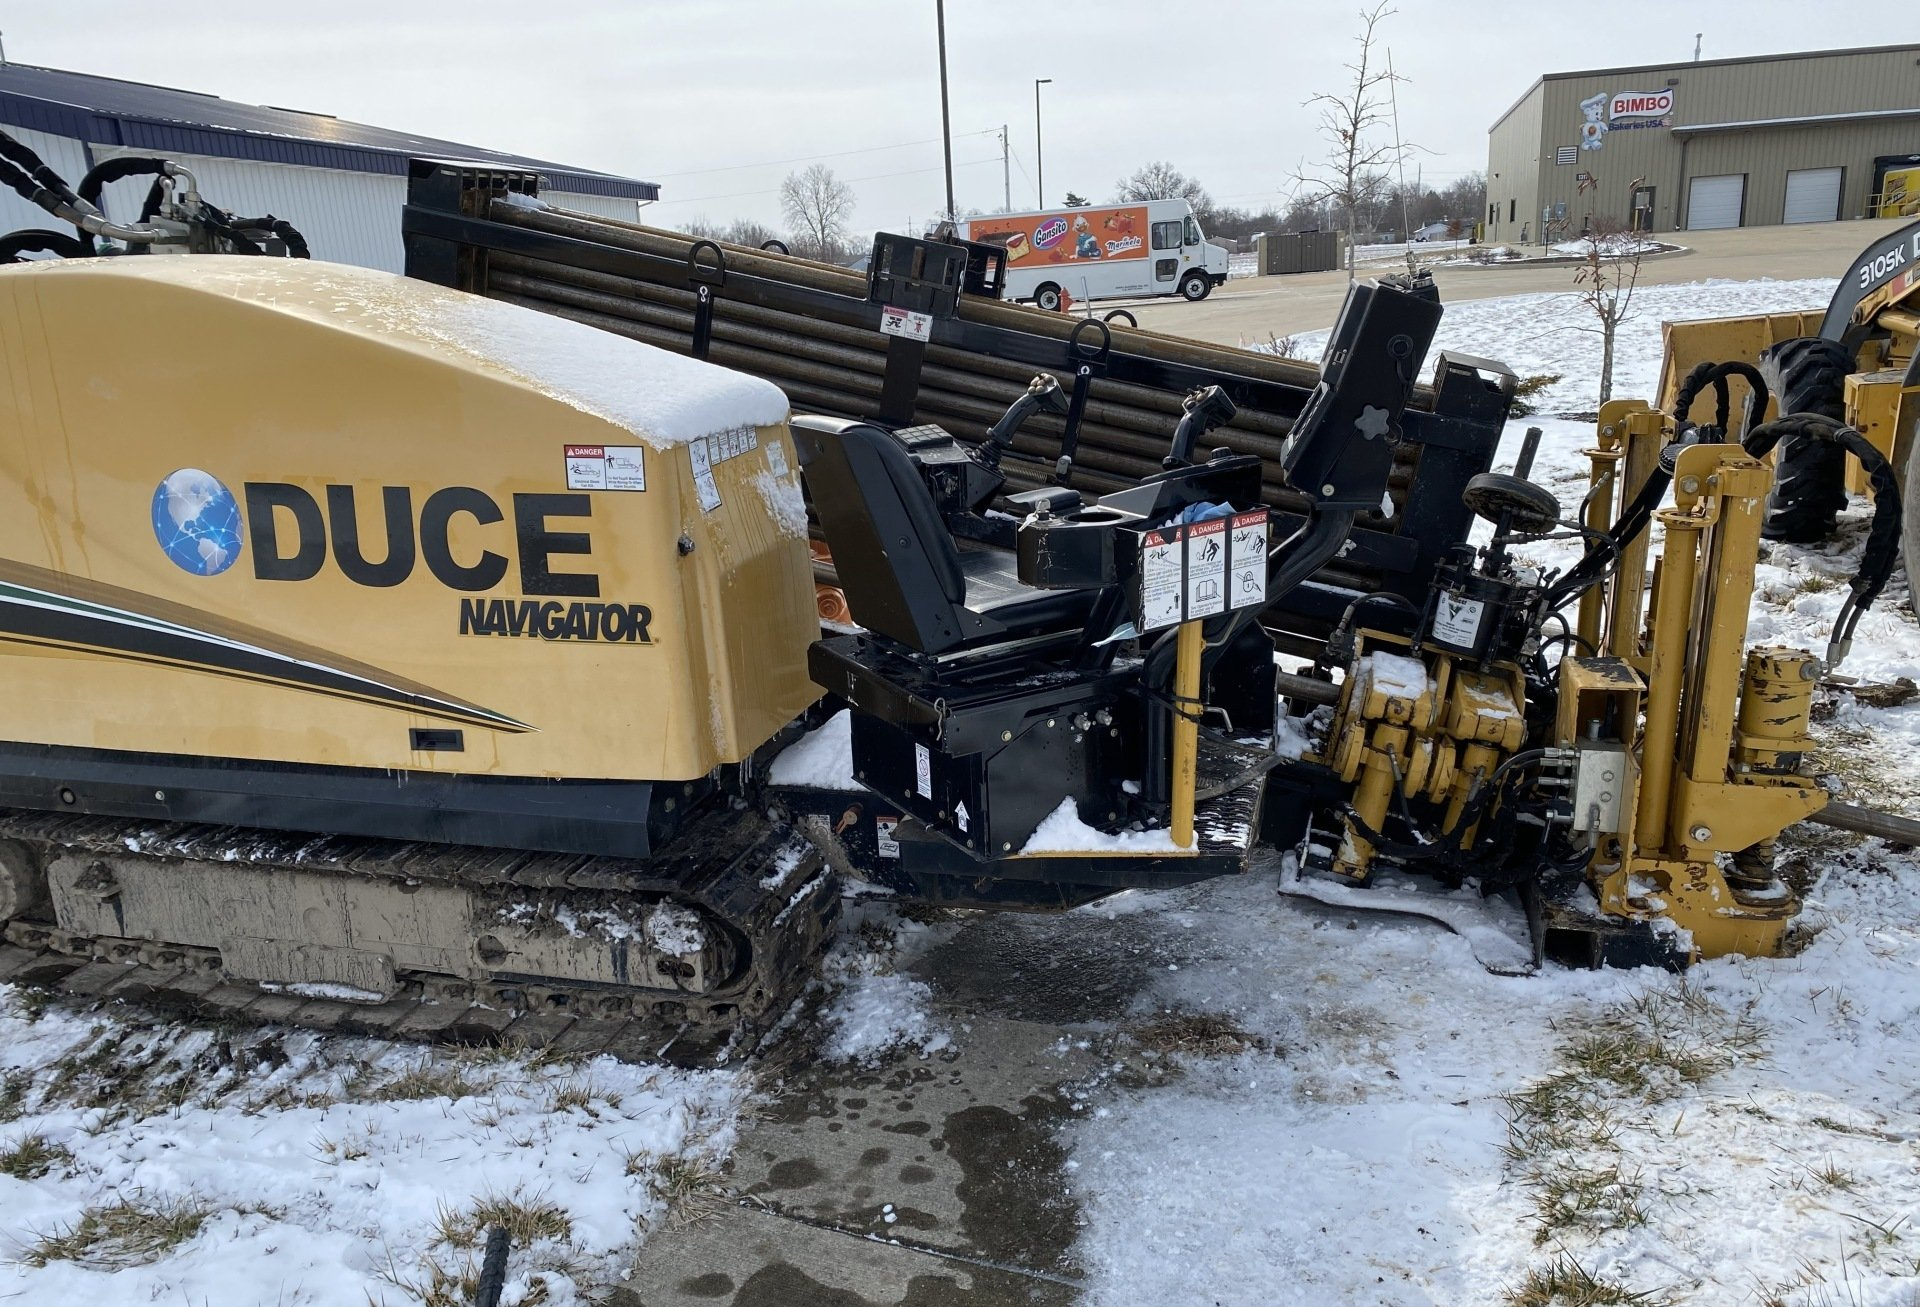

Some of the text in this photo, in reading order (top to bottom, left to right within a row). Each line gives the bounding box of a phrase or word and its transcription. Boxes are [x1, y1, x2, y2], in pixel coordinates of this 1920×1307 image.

[1614, 96, 1670, 113] BIMBO
[1608, 119, 1664, 131] Bakeries USA
[1035, 221, 1068, 247] Gansito
[1105, 236, 1142, 251] Marinela
[1860, 243, 1906, 289] 310SK
[574, 448, 603, 456] DANGER
[1241, 514, 1267, 525] DANGER
[1198, 522, 1225, 534] DANGER
[244, 481, 600, 597] DUCE
[1154, 531, 1182, 543] DAR
[460, 598, 654, 643] NAVIGATOR
